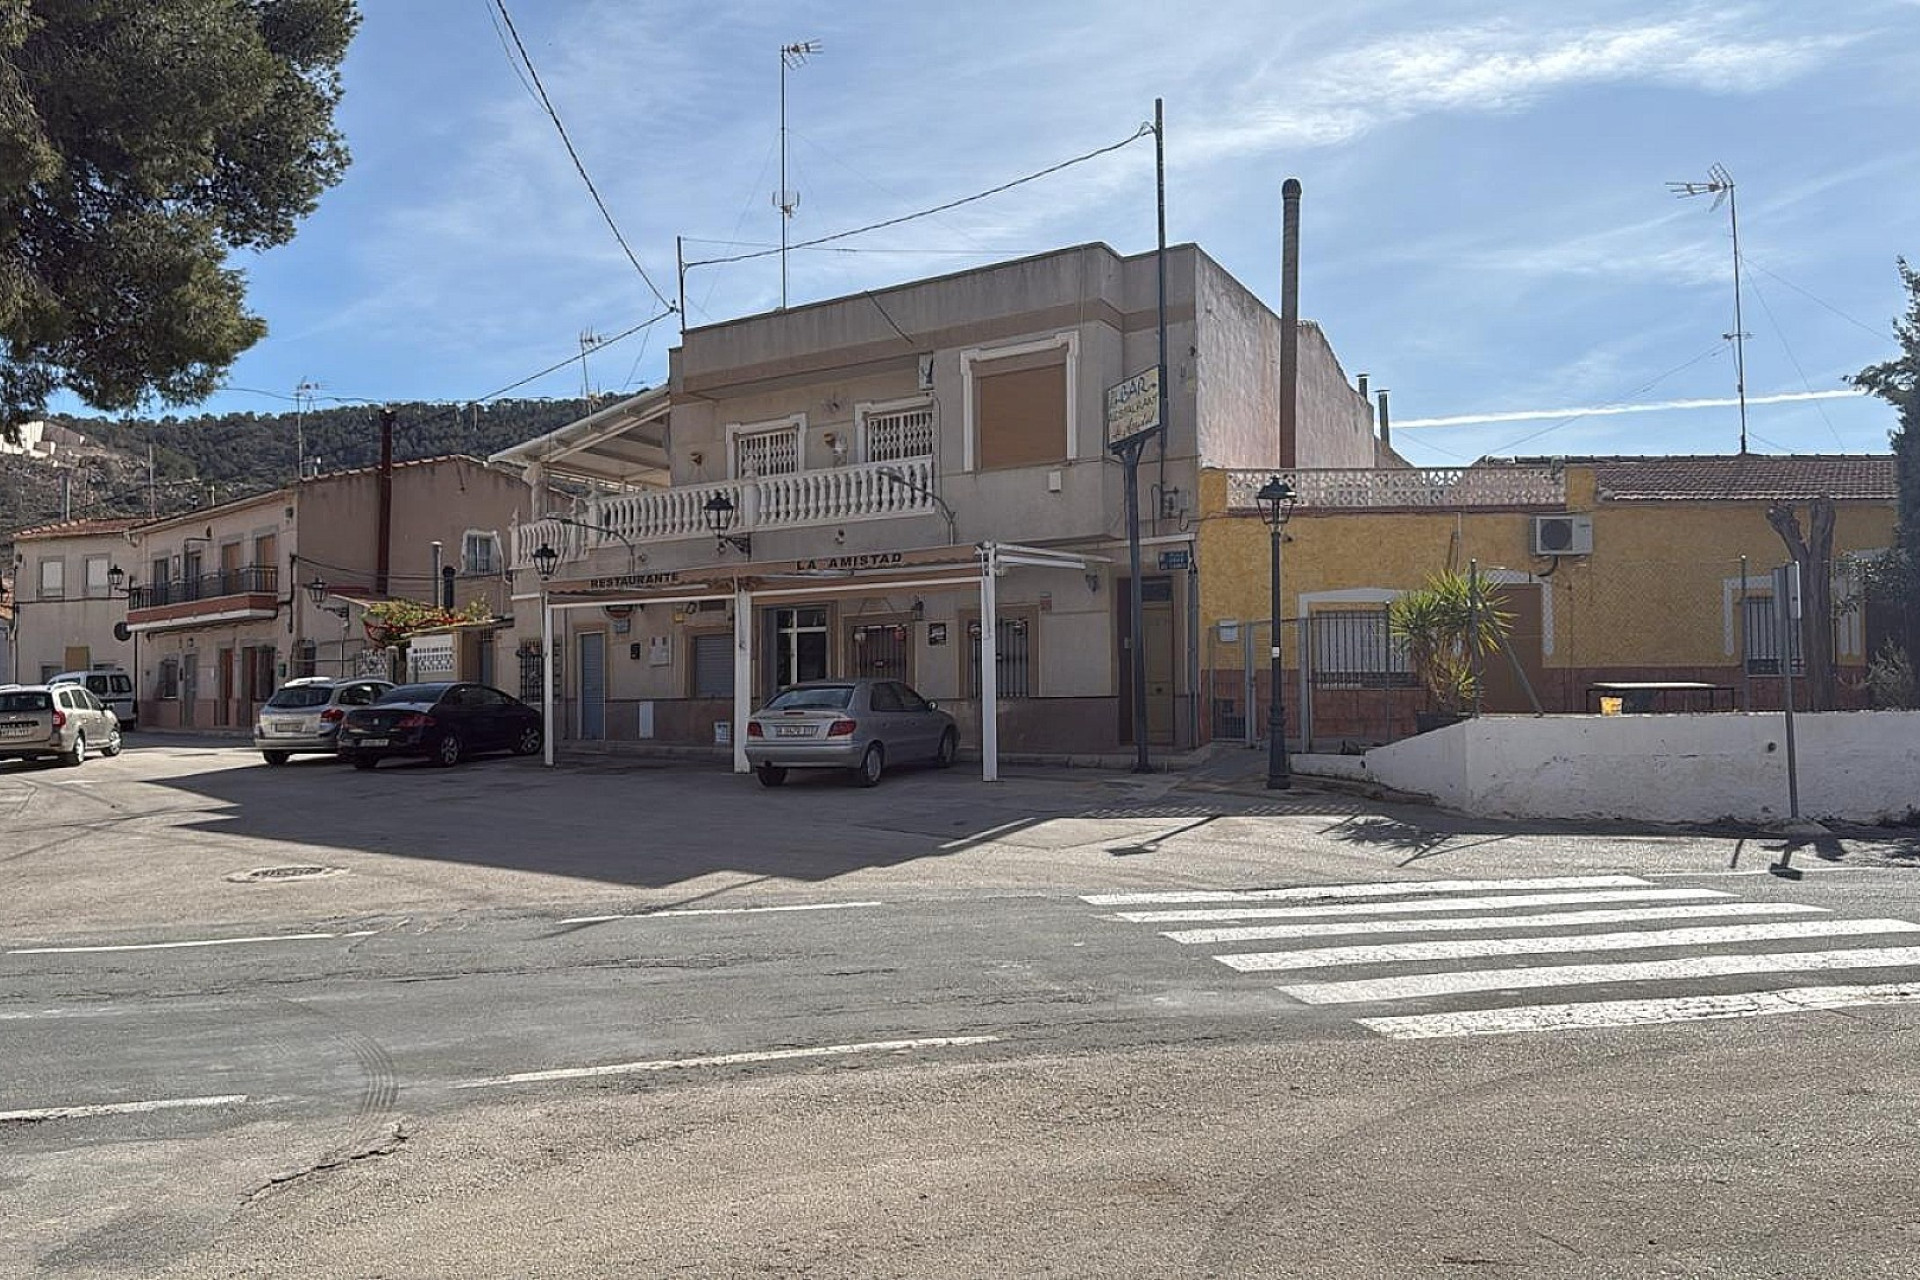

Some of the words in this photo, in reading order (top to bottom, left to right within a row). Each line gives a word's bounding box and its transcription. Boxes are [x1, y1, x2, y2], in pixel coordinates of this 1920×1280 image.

[796, 560, 816, 571] LA
[829, 553, 902, 568] AMISTAD
[590, 572, 679, 588] RESTAURANTE
